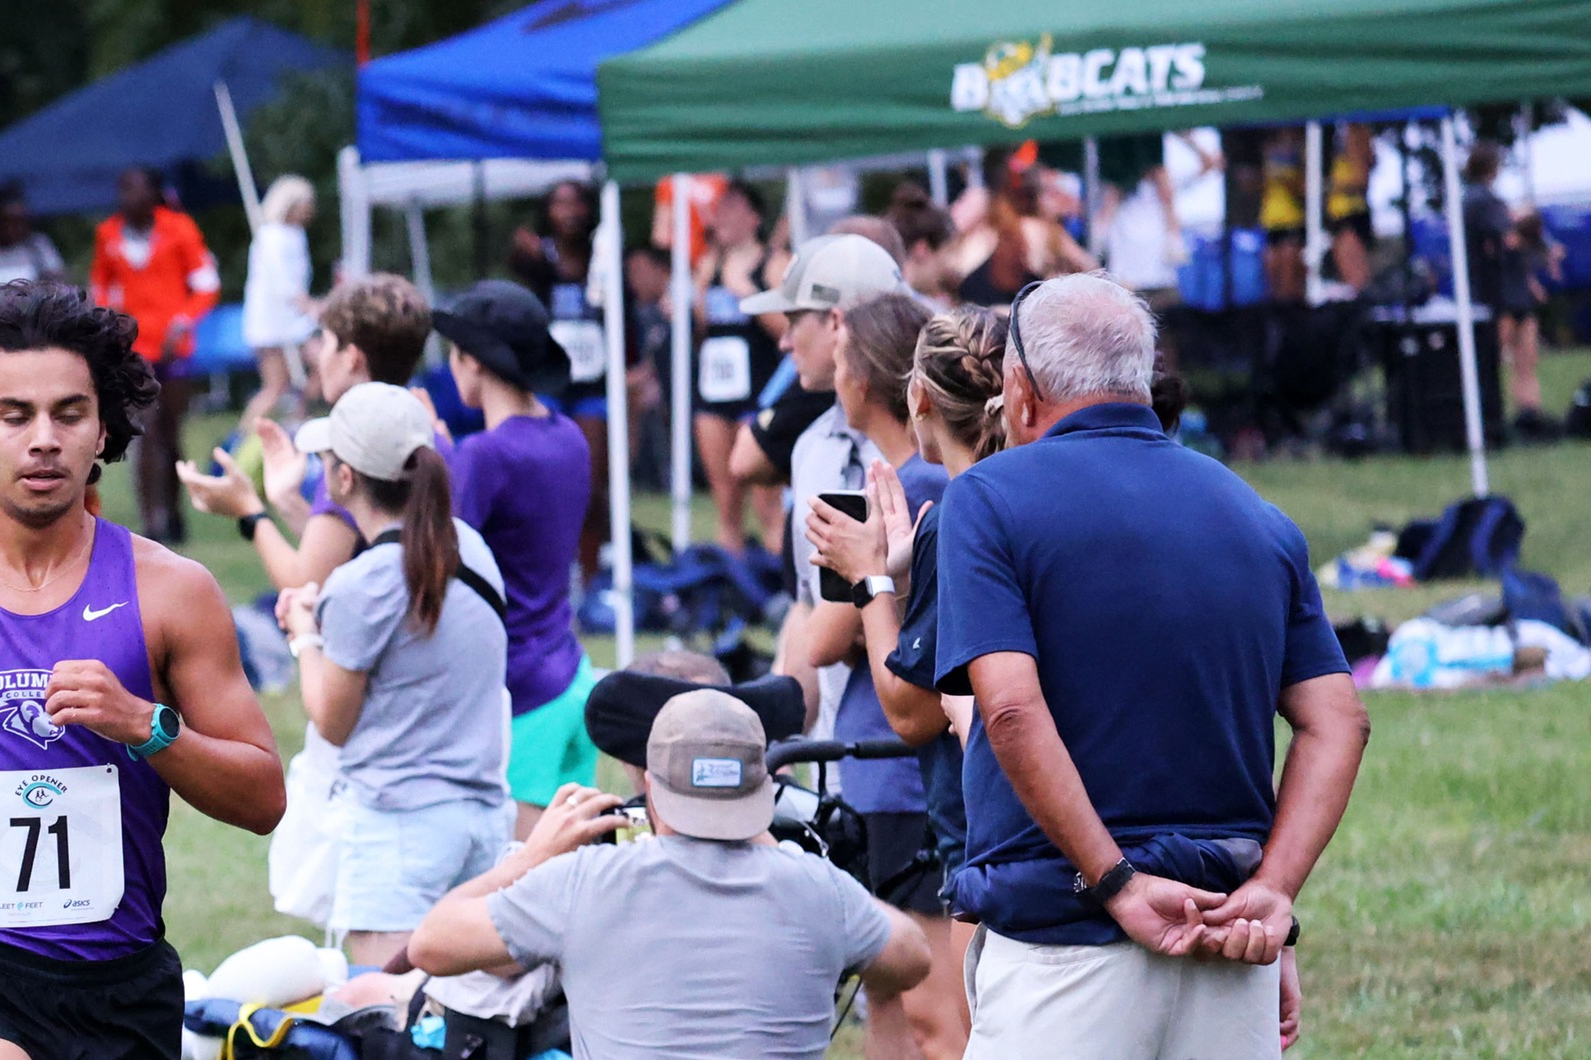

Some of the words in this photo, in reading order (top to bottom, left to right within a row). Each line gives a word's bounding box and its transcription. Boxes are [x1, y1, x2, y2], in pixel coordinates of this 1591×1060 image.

[5, 691, 42, 699] COLLE
[15, 780, 28, 796] EYE
[31, 775, 68, 793] OPENER
[10, 815, 72, 893] 71
